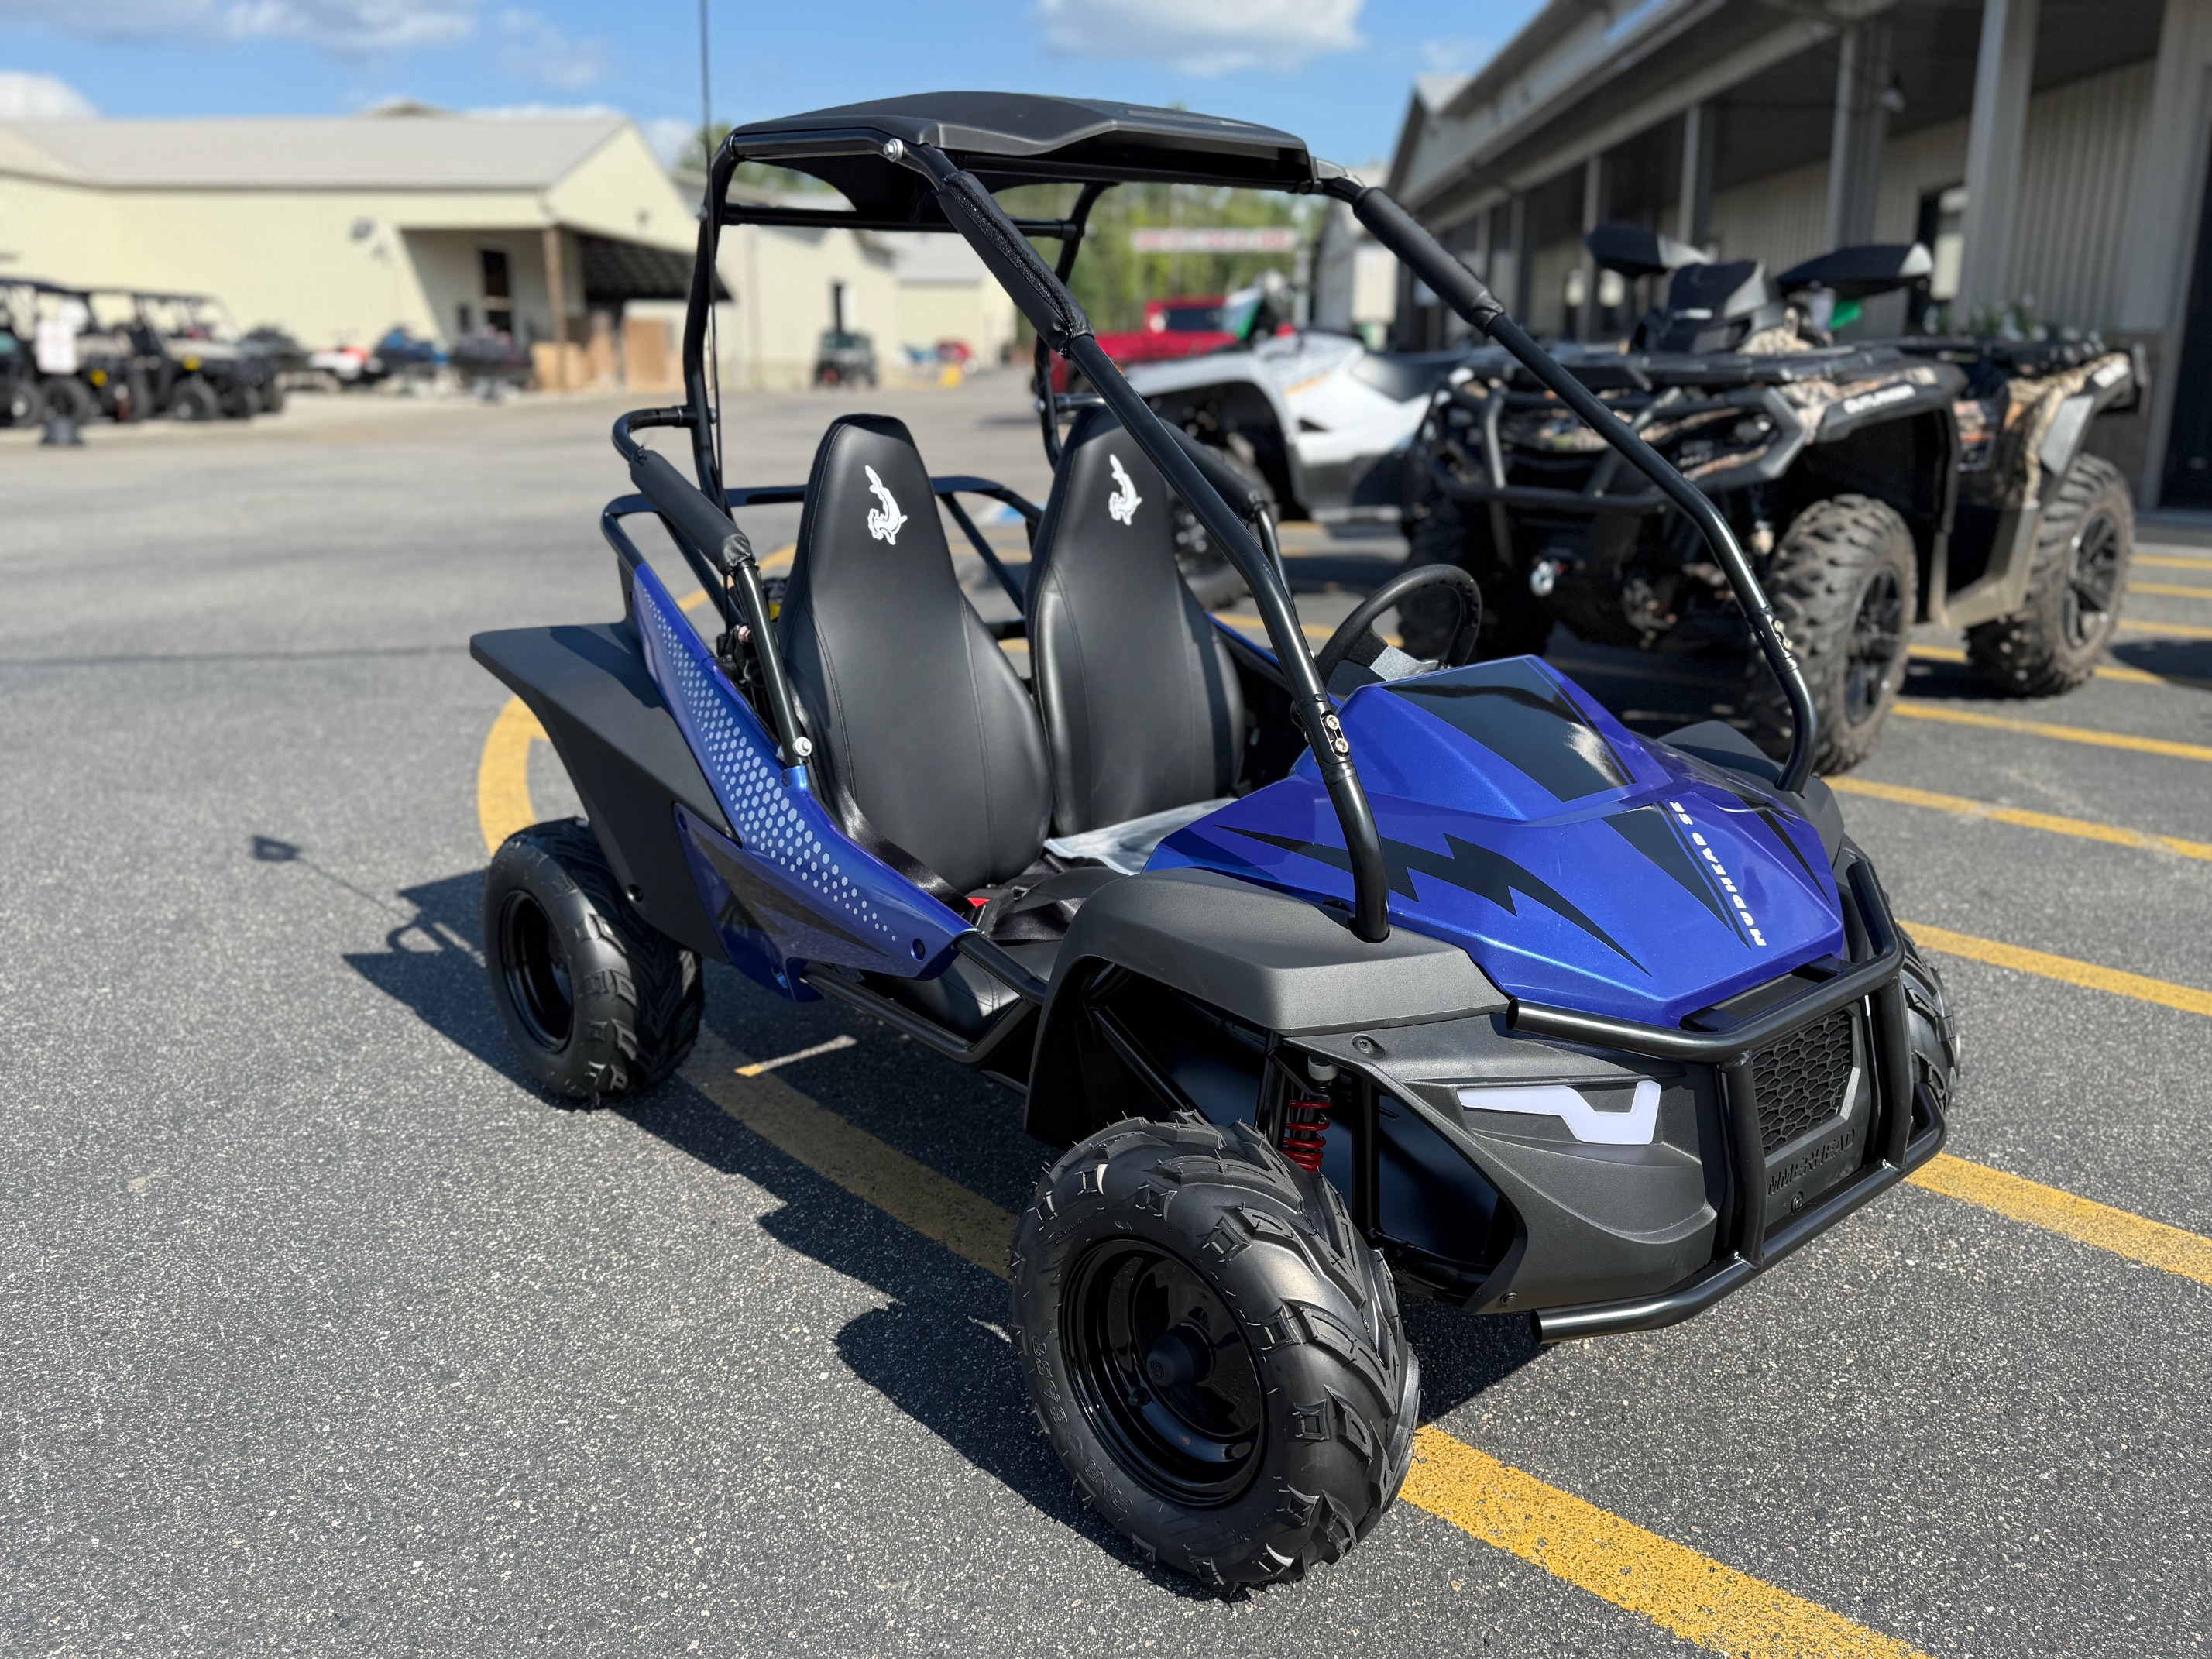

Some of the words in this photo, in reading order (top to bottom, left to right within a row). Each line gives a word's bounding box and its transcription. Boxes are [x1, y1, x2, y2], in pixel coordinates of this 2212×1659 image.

[1668, 802, 1694, 826] SE
[1692, 831, 1767, 946] MUDHEAD
[1767, 1128, 1856, 1197] MMERHEAD
